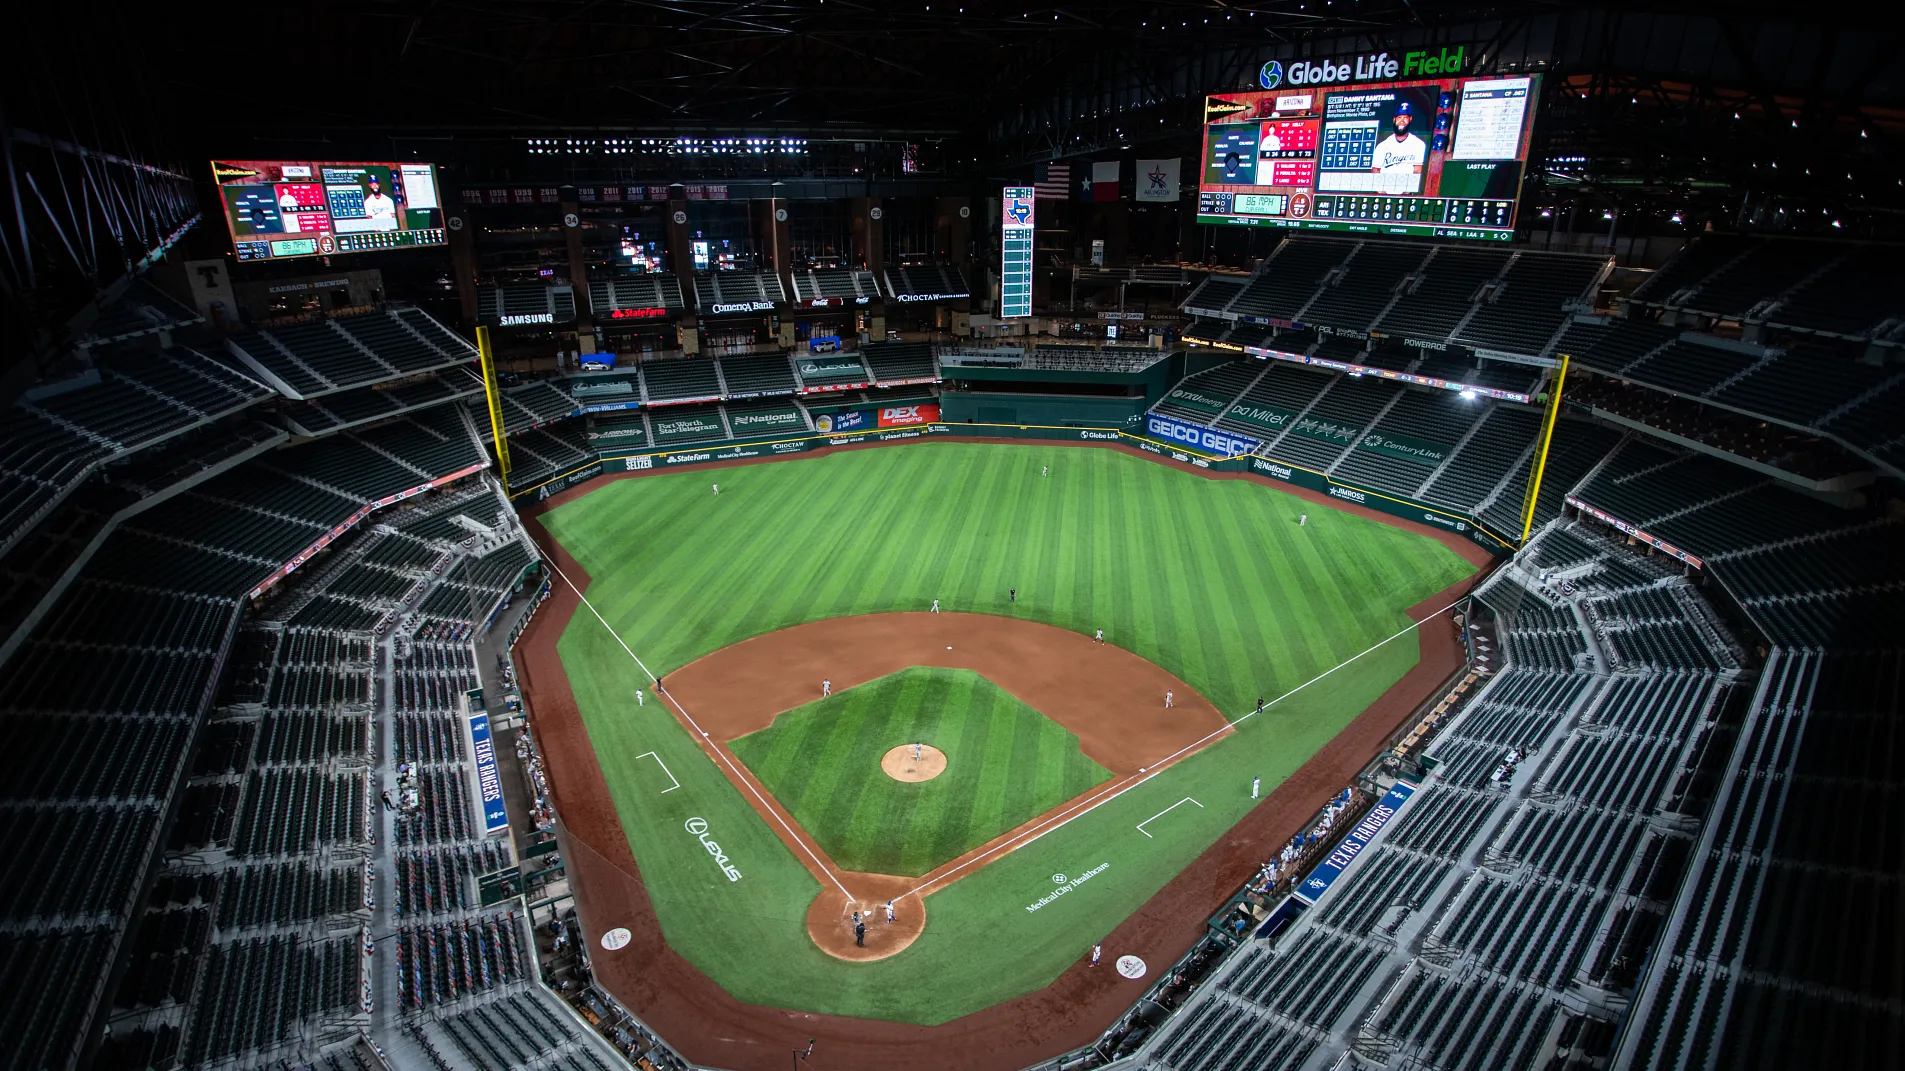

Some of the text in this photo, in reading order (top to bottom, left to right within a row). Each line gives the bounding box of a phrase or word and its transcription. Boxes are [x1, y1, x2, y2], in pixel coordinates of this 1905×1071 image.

[1288, 46, 1464, 84] Globe Life Field
[1382, 152, 1416, 168] Rangers
[1246, 197, 1274, 206] 86 MPH
[567, 216, 577, 225] 34
[198, 266, 218, 288] T
[269, 278, 349, 293] KARBACH BREWING
[902, 293, 940, 302] CHOCTAW
[752, 301, 774, 310] Bank
[622, 308, 666, 319] StateFarm
[501, 314, 553, 326] SAMSUNG
[1212, 342, 1243, 351] RoofClaim.com
[1404, 339, 1447, 351] POWERADE
[1181, 392, 1226, 408] TXUenergy
[749, 413, 798, 423] National
[883, 406, 920, 419] DEX
[1250, 410, 1288, 424] Mitel
[674, 420, 703, 428] Worth
[892, 416, 922, 424] imaging
[658, 423, 718, 435] Star-Telegram
[1150, 418, 1199, 444] GEICO
[1384, 440, 1441, 459] CenturyLink
[677, 453, 710, 462] StateFarm
[626, 459, 652, 470] SELTZER
[1262, 461, 1291, 476] National
[569, 466, 601, 482] RoofClaim.com
[549, 482, 565, 492] TEXAS
[475, 738, 500, 802] TEXAS RANGERS
[1325, 805, 1394, 870] TEXAS RANGERS
[699, 832, 742, 882] LEXUS
[1026, 862, 1109, 913] Medical City Healthcare
